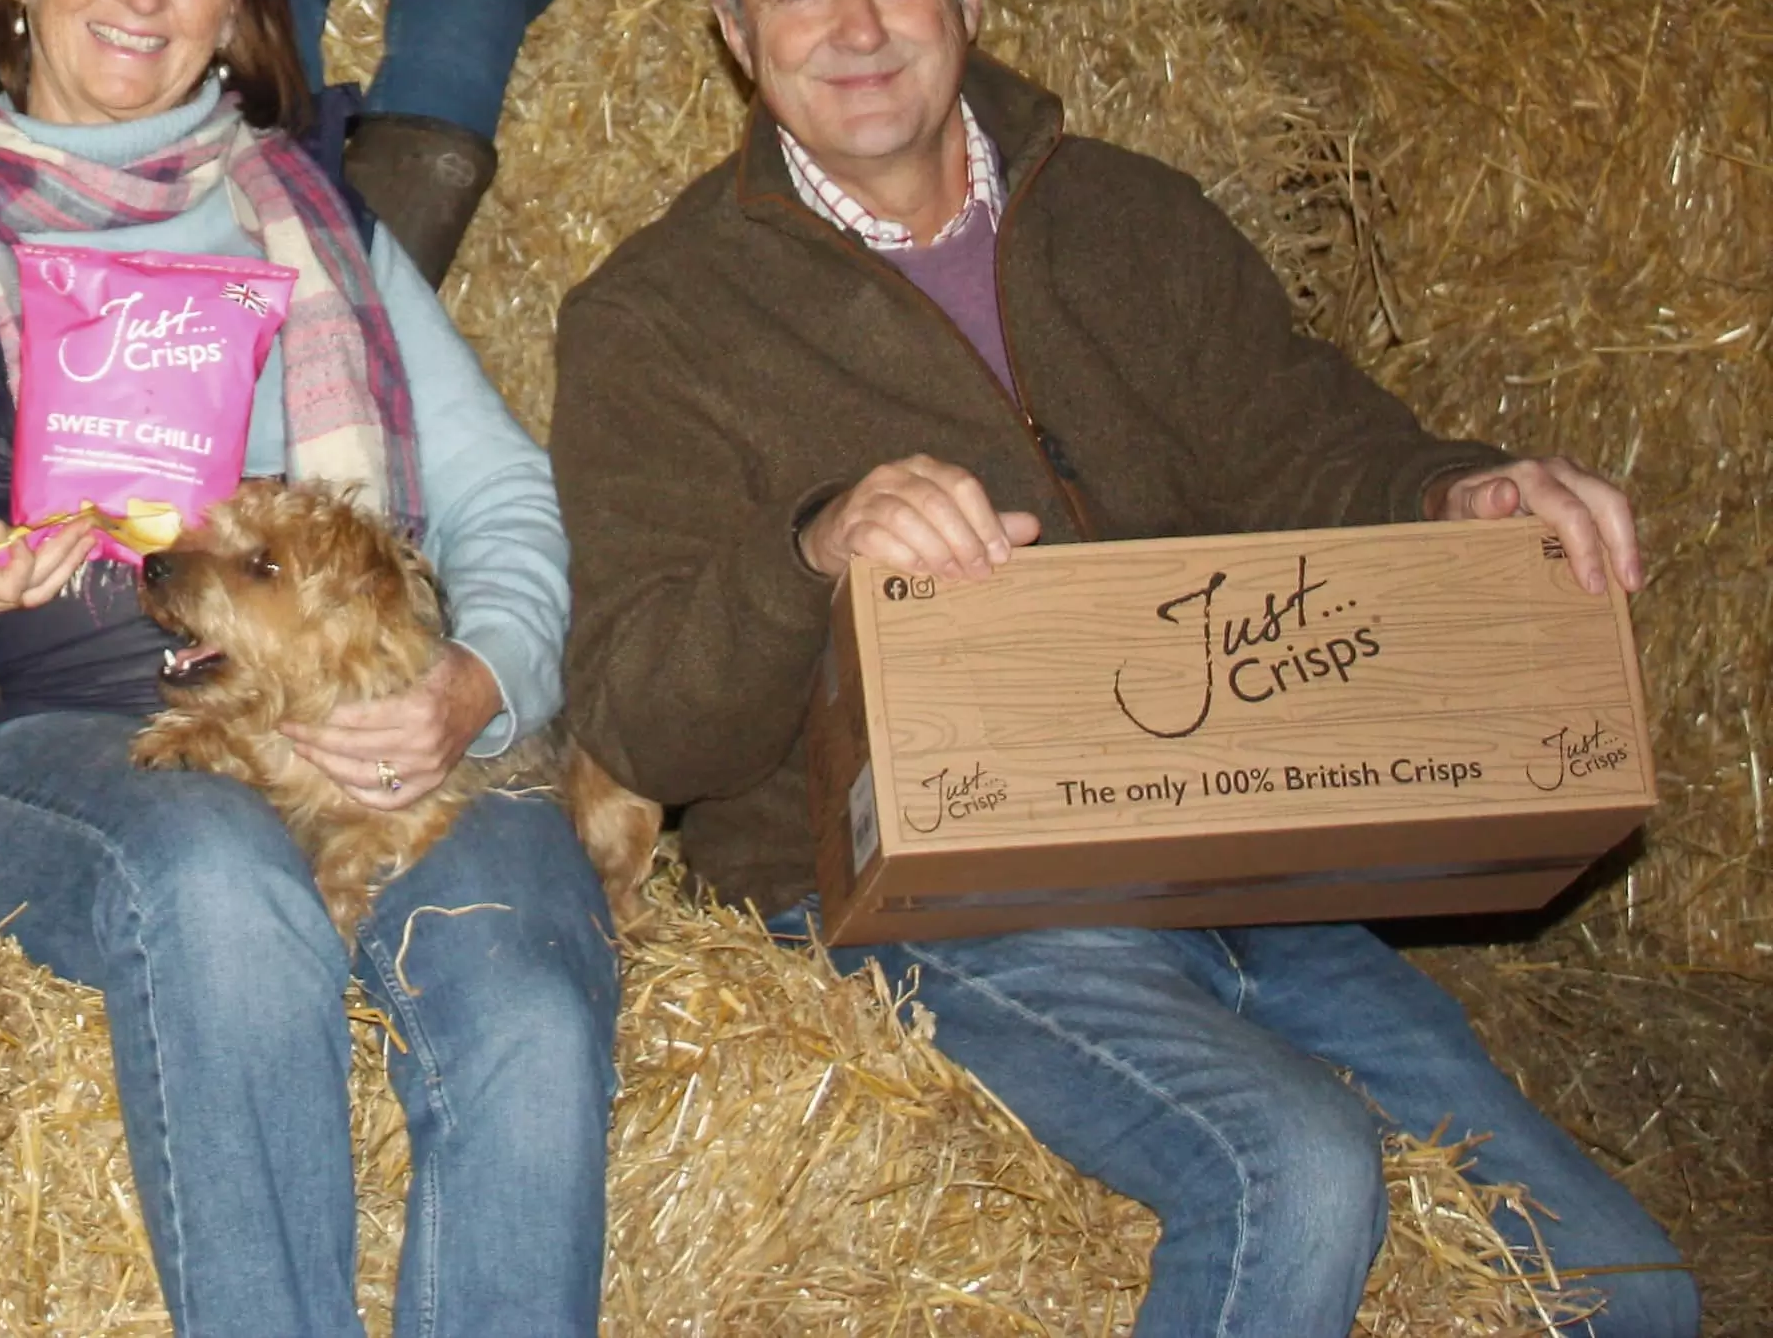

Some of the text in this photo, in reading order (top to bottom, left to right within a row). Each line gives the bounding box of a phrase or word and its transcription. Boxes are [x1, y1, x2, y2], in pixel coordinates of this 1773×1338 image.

[124, 341, 223, 372] Crisps
[47, 413, 212, 455] SWEET CHILLI
[1229, 627, 1380, 702] Crisps
[1570, 747, 1627, 777] Crisps
[1056, 758, 1484, 806] The only 100% British Crisps
[948, 787, 1007, 819] Crisps
